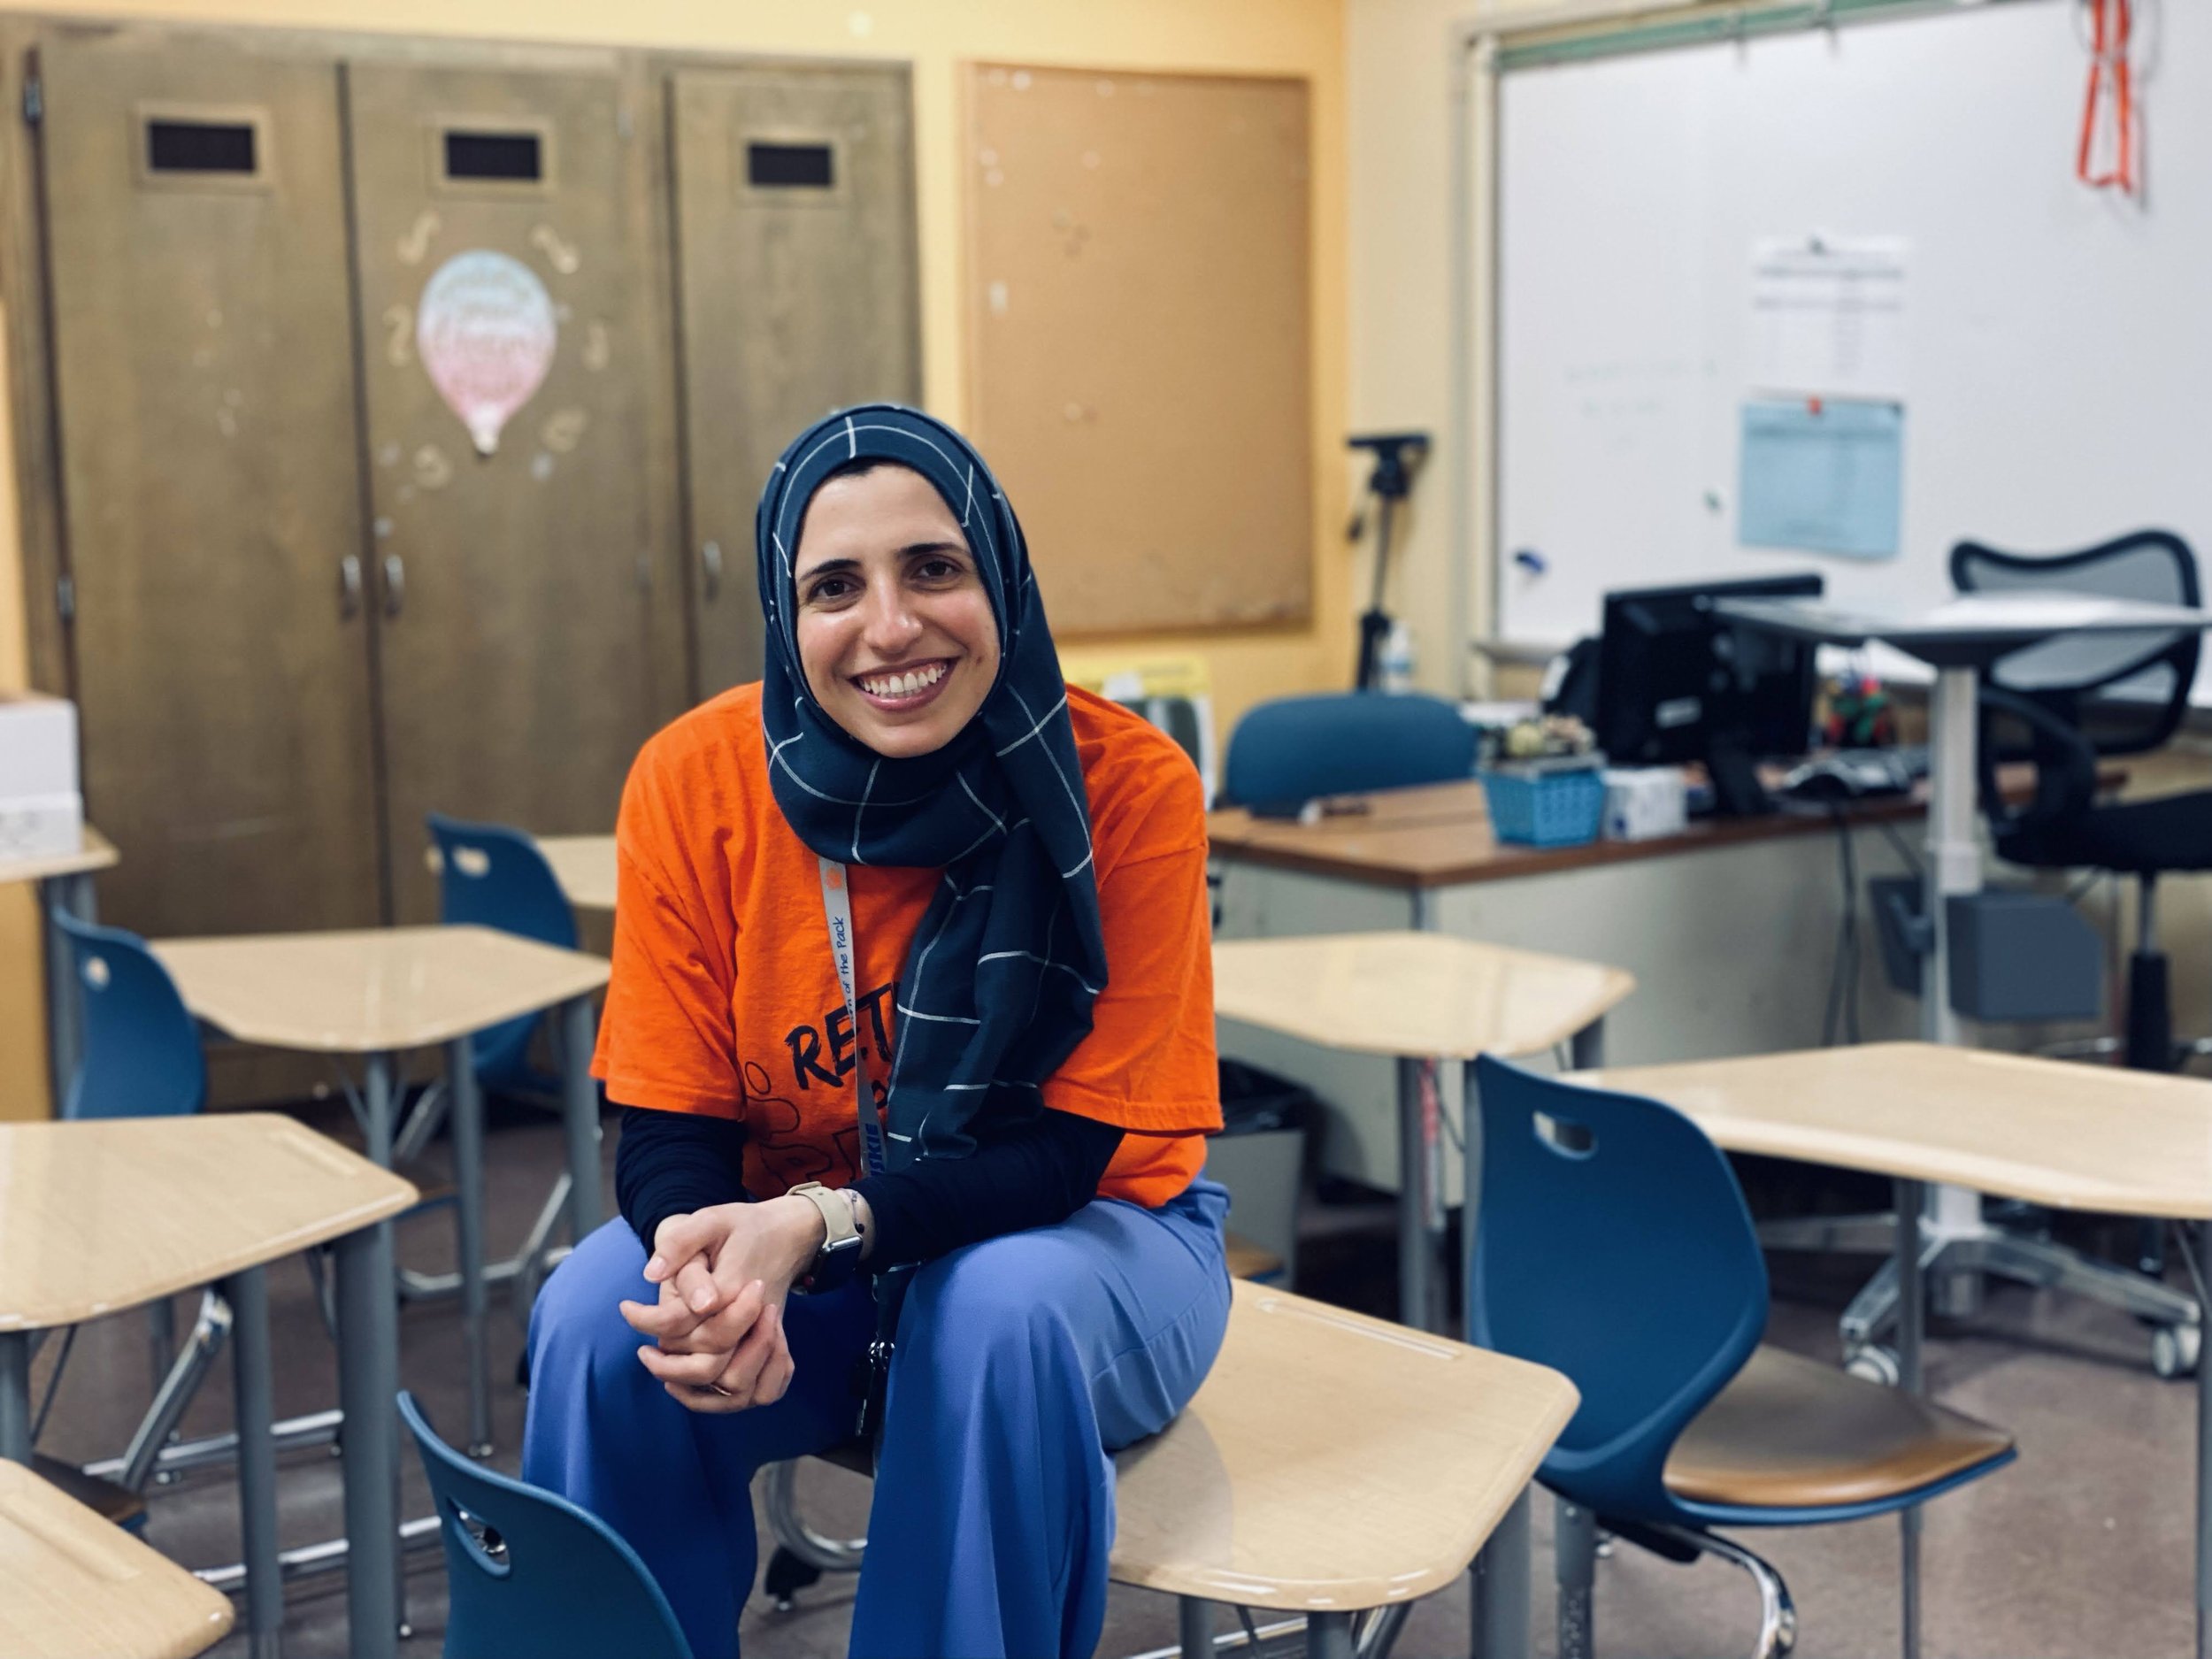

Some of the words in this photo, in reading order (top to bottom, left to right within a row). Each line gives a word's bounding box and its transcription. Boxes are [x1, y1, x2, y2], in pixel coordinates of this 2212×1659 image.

[833, 917, 847, 949] Pack
[842, 981, 851, 994] of
[785, 982, 900, 1090] RET
